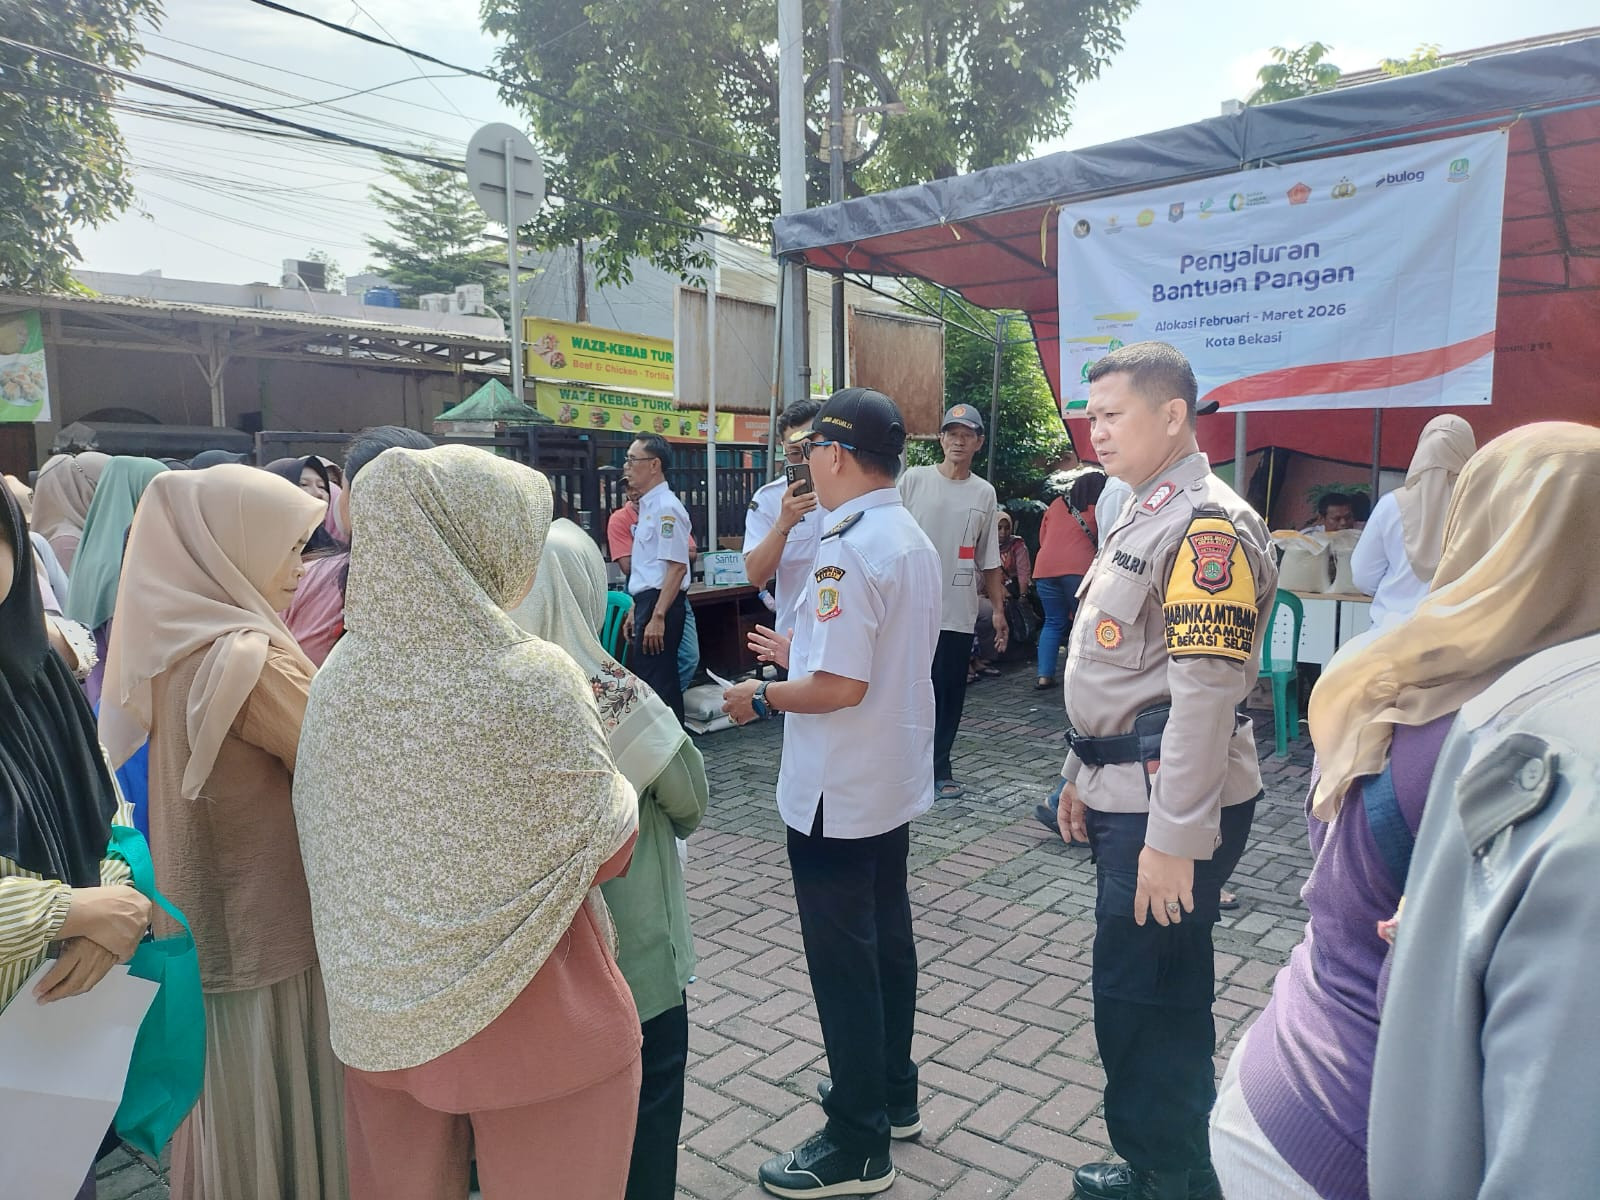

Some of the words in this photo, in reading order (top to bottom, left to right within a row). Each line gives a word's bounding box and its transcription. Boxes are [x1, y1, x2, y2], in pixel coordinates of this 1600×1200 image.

[1386, 170, 1425, 183] bulog
[1179, 241, 1321, 275] Penyaluran
[1152, 275, 1247, 303] Bantuan
[1254, 265, 1355, 292] Pangan
[1155, 317, 1198, 332] Alokasi
[1199, 311, 1250, 328] Februari
[1261, 307, 1304, 322] Maret
[1307, 303, 1347, 318] 2026
[571, 336, 648, 359] WAZE-KEBAB
[650, 349, 673, 364] TUR
[1205, 336, 1235, 349] Kota
[1238, 331, 1282, 346] Bekasi
[572, 359, 593, 370] Beef
[605, 364, 638, 377] Chicken
[559, 388, 595, 402] WAZE
[599, 394, 639, 408] KEBAB
[641, 398, 689, 414] TURK
[1111, 549, 1147, 576] POLRI
[1177, 634, 1218, 647] BEKASI
